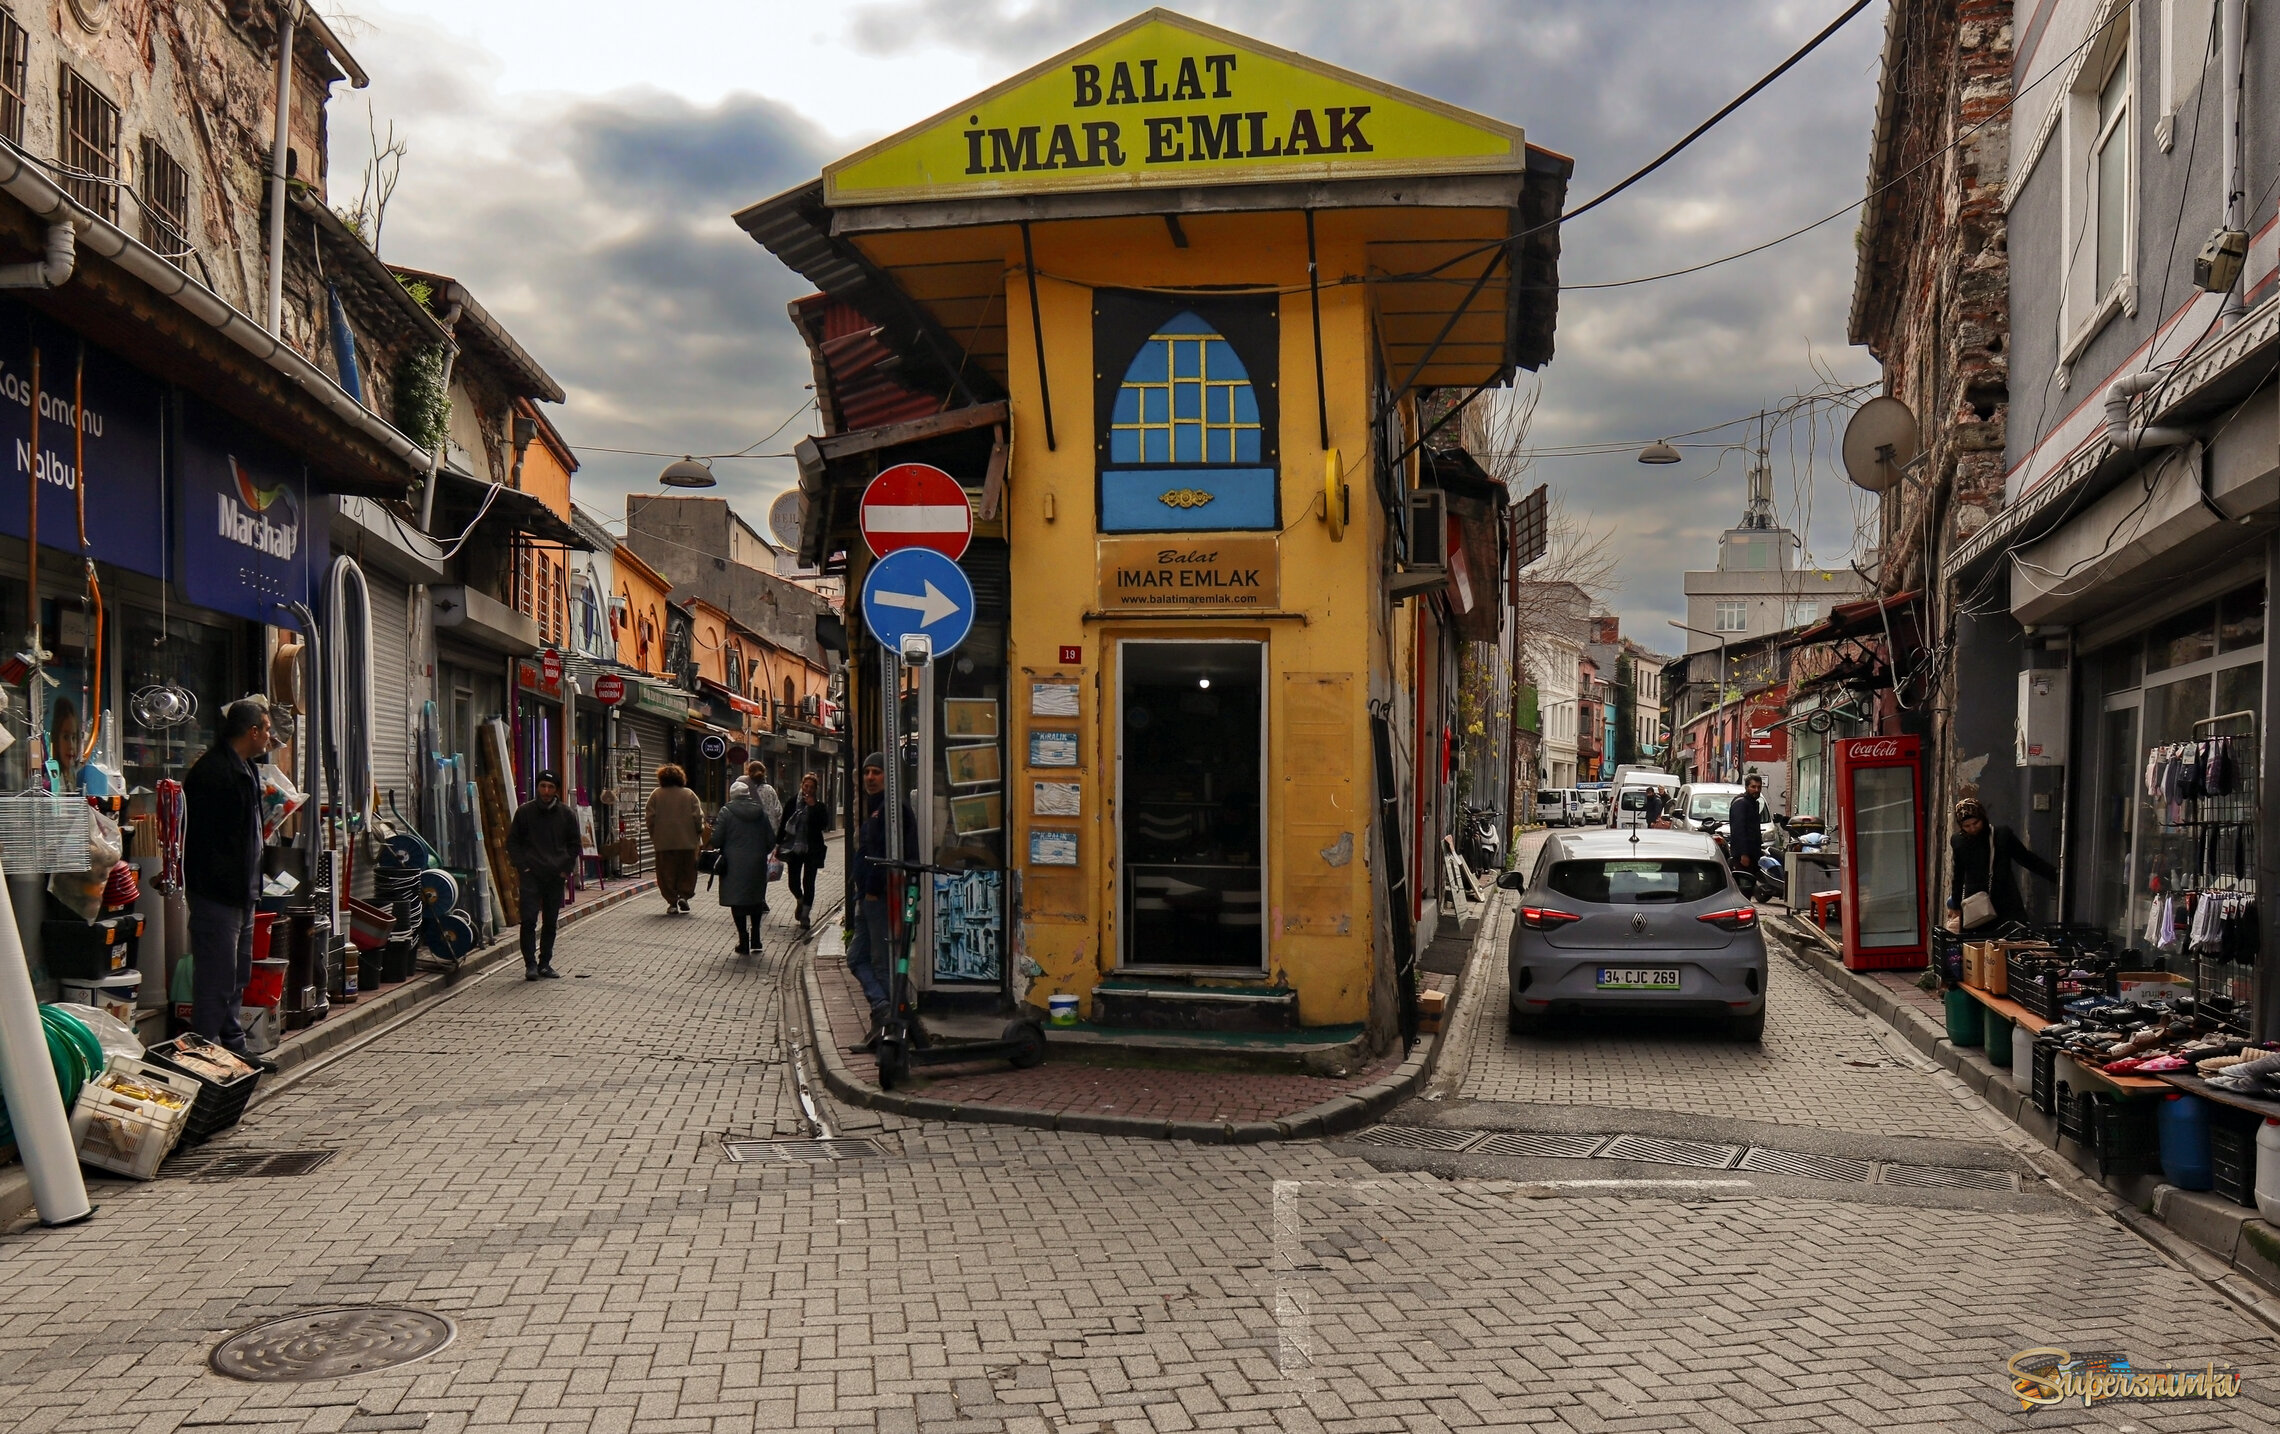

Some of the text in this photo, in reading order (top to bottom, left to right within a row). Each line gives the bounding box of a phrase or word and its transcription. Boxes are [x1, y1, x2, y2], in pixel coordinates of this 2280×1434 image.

[1072, 54, 1237, 108] BALAT
[963, 106, 1374, 175] İMAR EMLAK
[16, 438, 84, 491] Nalbu
[217, 491, 291, 561] Marshall
[1157, 550, 1218, 564] Balat
[1117, 567, 1260, 588] İMAR EMLAK
[1121, 594, 1257, 604] www.balatimaremlak.com
[1605, 970, 1676, 985] 34 CJC 269
